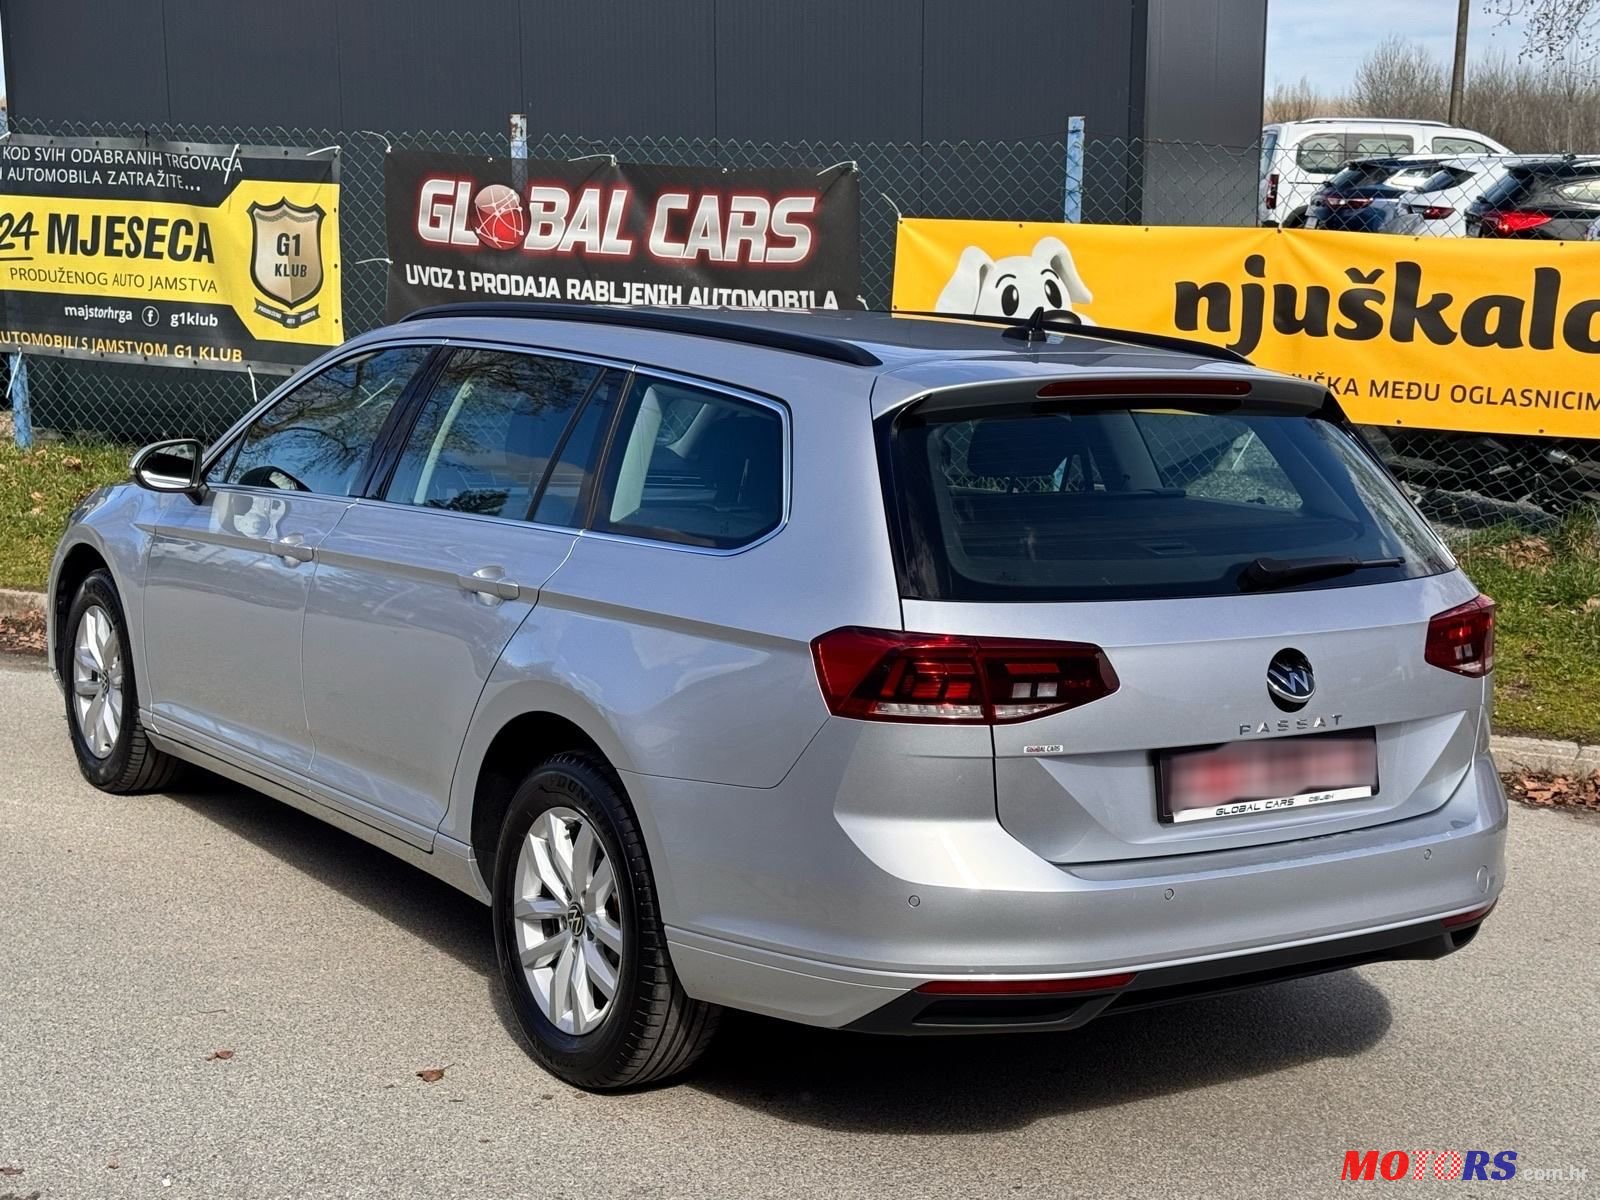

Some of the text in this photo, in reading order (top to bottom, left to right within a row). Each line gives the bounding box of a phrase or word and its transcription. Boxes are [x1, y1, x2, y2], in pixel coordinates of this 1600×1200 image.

[3, 146, 30, 160] KOD
[35, 147, 65, 162] SVIH
[71, 148, 162, 166] ODABRANIH
[8, 167, 102, 184] AUTOMOBILA
[107, 169, 200, 191] ZATRAŽITE...
[0, 211, 215, 264] 24 MJESECA
[648, 193, 816, 264] CARS
[276, 232, 301, 256] G1
[10, 267, 218, 293] PRODUŽENOG AUTO JAMSTVA
[275, 263, 307, 278] KLUB
[406, 264, 839, 310] UVOZ I PRODAJA RABLJENIH AUTOMOBILA
[64, 305, 133, 323] majstorhrga
[170, 312, 218, 327] g1klub
[0, 331, 243, 363] UTOMOBILI S JAMSTVOM G1 KLUB
[1369, 379, 1440, 402] MEĐU
[1239, 714, 1342, 736] PASSAT
[1216, 803, 1260, 816] GLOBAL
[1265, 798, 1295, 809] CARS
